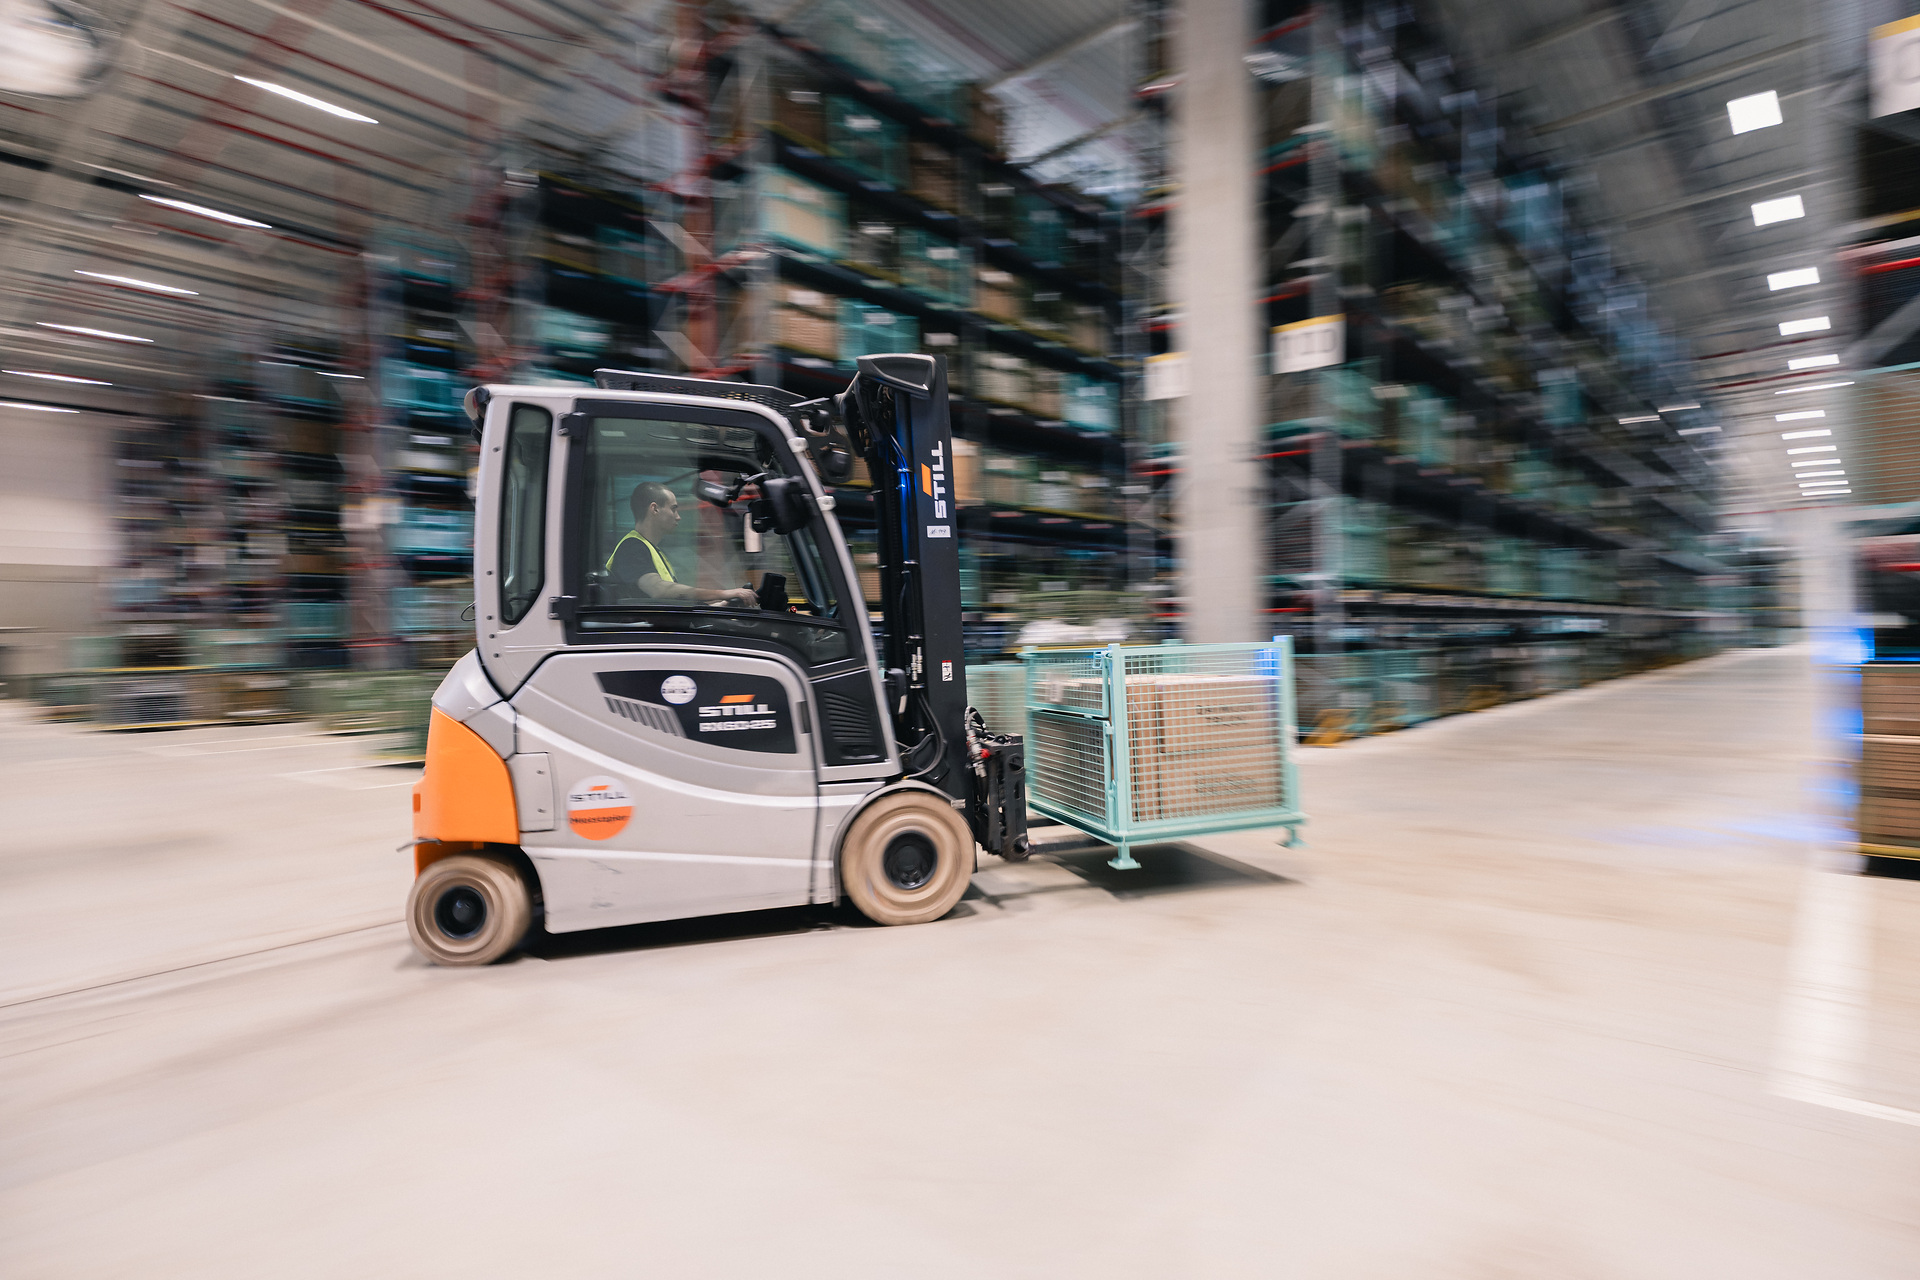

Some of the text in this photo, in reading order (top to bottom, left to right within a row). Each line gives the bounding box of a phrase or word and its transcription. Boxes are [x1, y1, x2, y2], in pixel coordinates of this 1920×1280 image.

[931, 440, 948, 519] STILL
[698, 704, 777, 717] STILL
[569, 791, 630, 802] STILL
